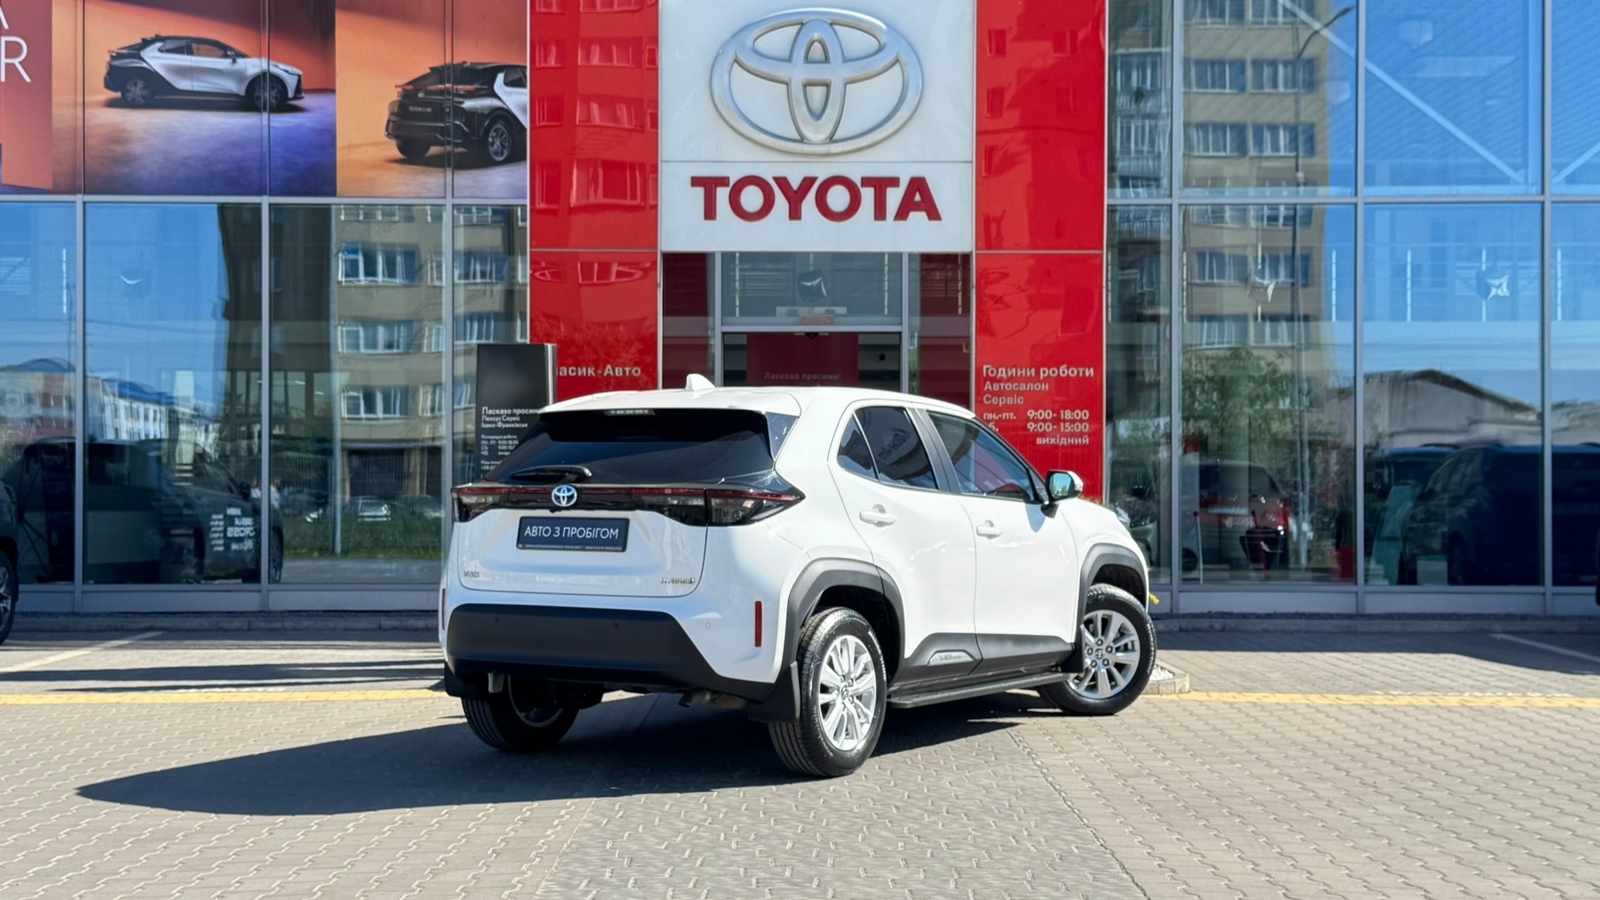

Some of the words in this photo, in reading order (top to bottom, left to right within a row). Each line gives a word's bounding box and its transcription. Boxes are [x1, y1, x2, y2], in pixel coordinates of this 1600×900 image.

[690, 175, 943, 222] TOYOTA
[983, 365, 1036, 379] Години
[1039, 364, 1094, 380] роботи
[983, 381, 1049, 391] Автосалон
[983, 394, 1025, 406] Сервіс
[1036, 435, 1090, 447] вихідний
[524, 525, 552, 538] АВТО
[562, 527, 620, 540] ПРОБІГОМ
